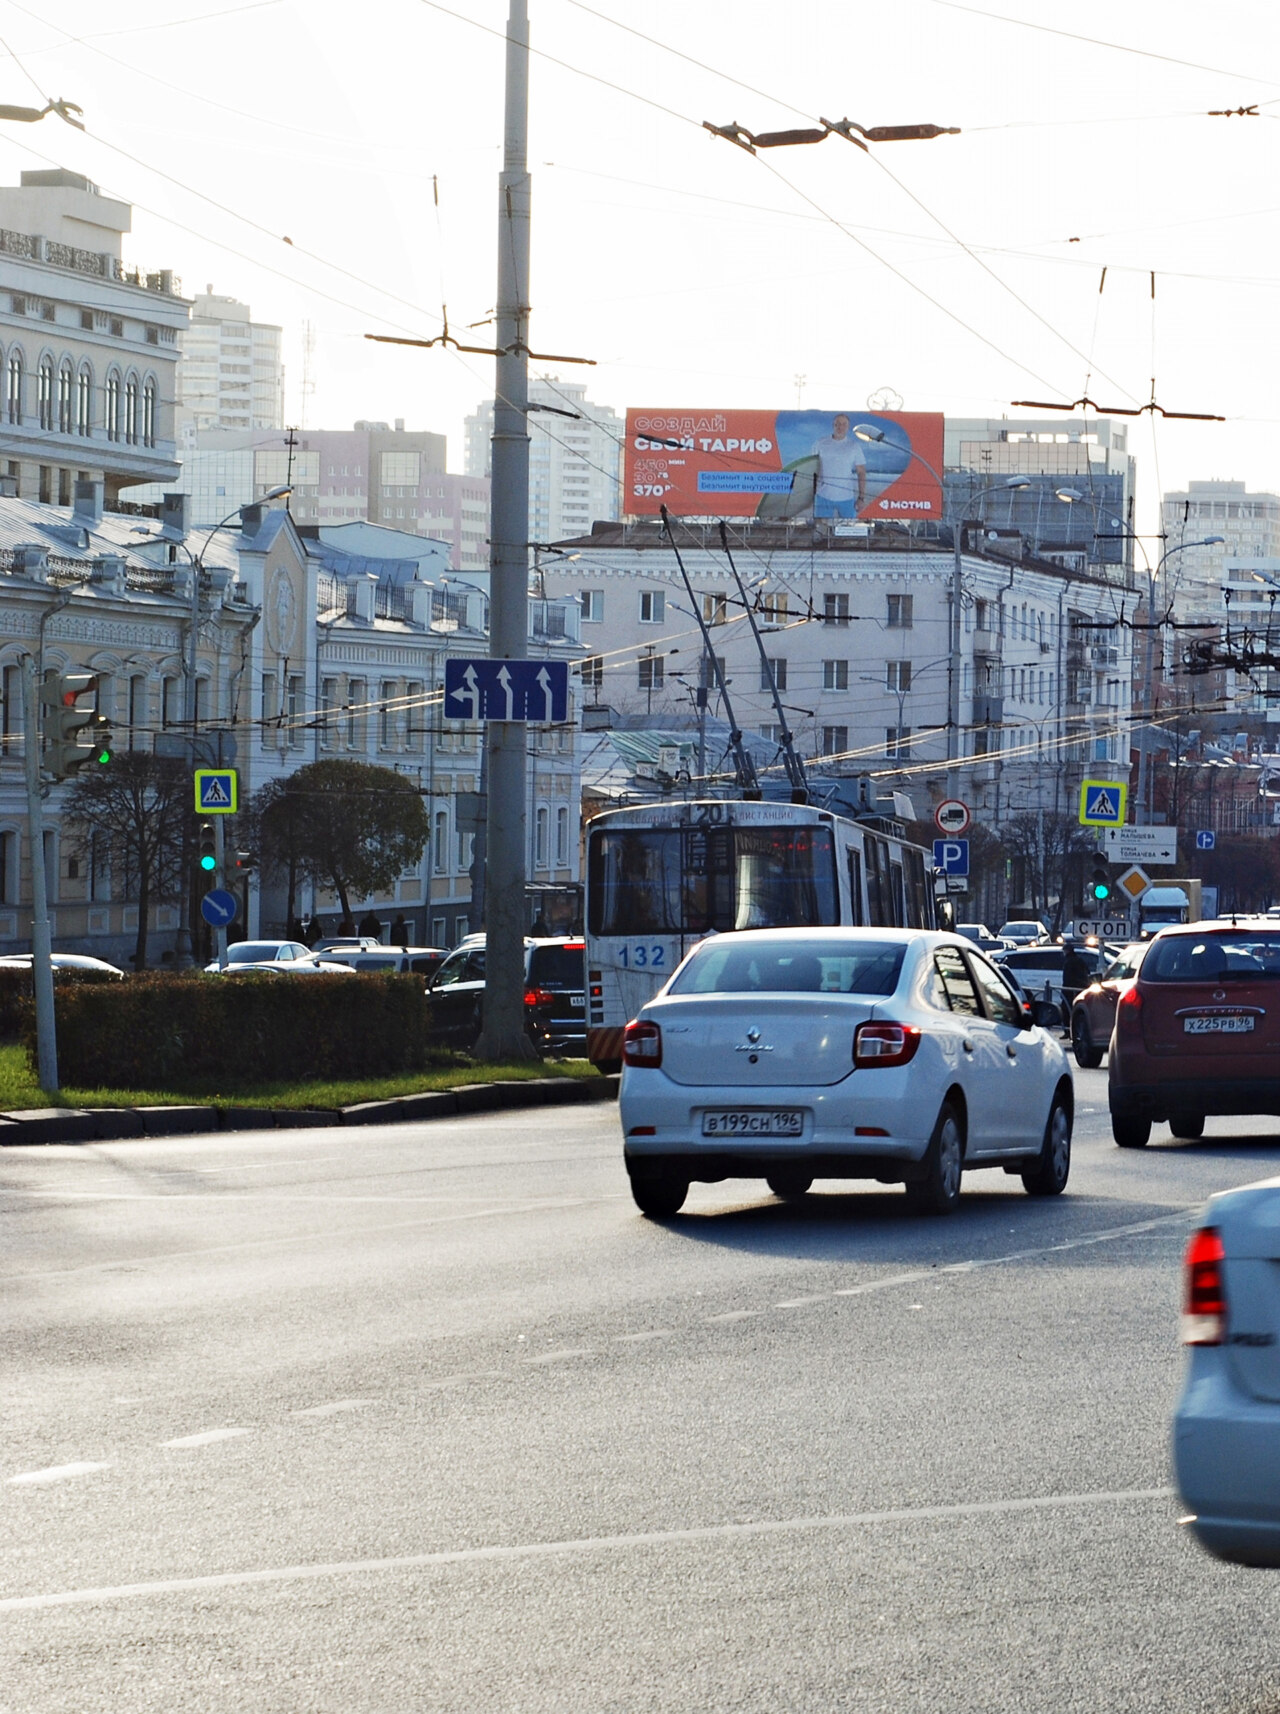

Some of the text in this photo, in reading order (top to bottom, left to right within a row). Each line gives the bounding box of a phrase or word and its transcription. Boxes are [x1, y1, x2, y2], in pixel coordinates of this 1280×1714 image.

[634, 414, 726, 435] СОЗДАЙ
[699, 437, 772, 453] ТАРИФ
[701, 473, 740, 481] Безлимит
[633, 484, 664, 497] 370
[697, 804, 722, 824] 20
[1079, 921, 1126, 936] СТОП
[618, 944, 665, 968] 132
[708, 1113, 799, 1131] В199СН 196
